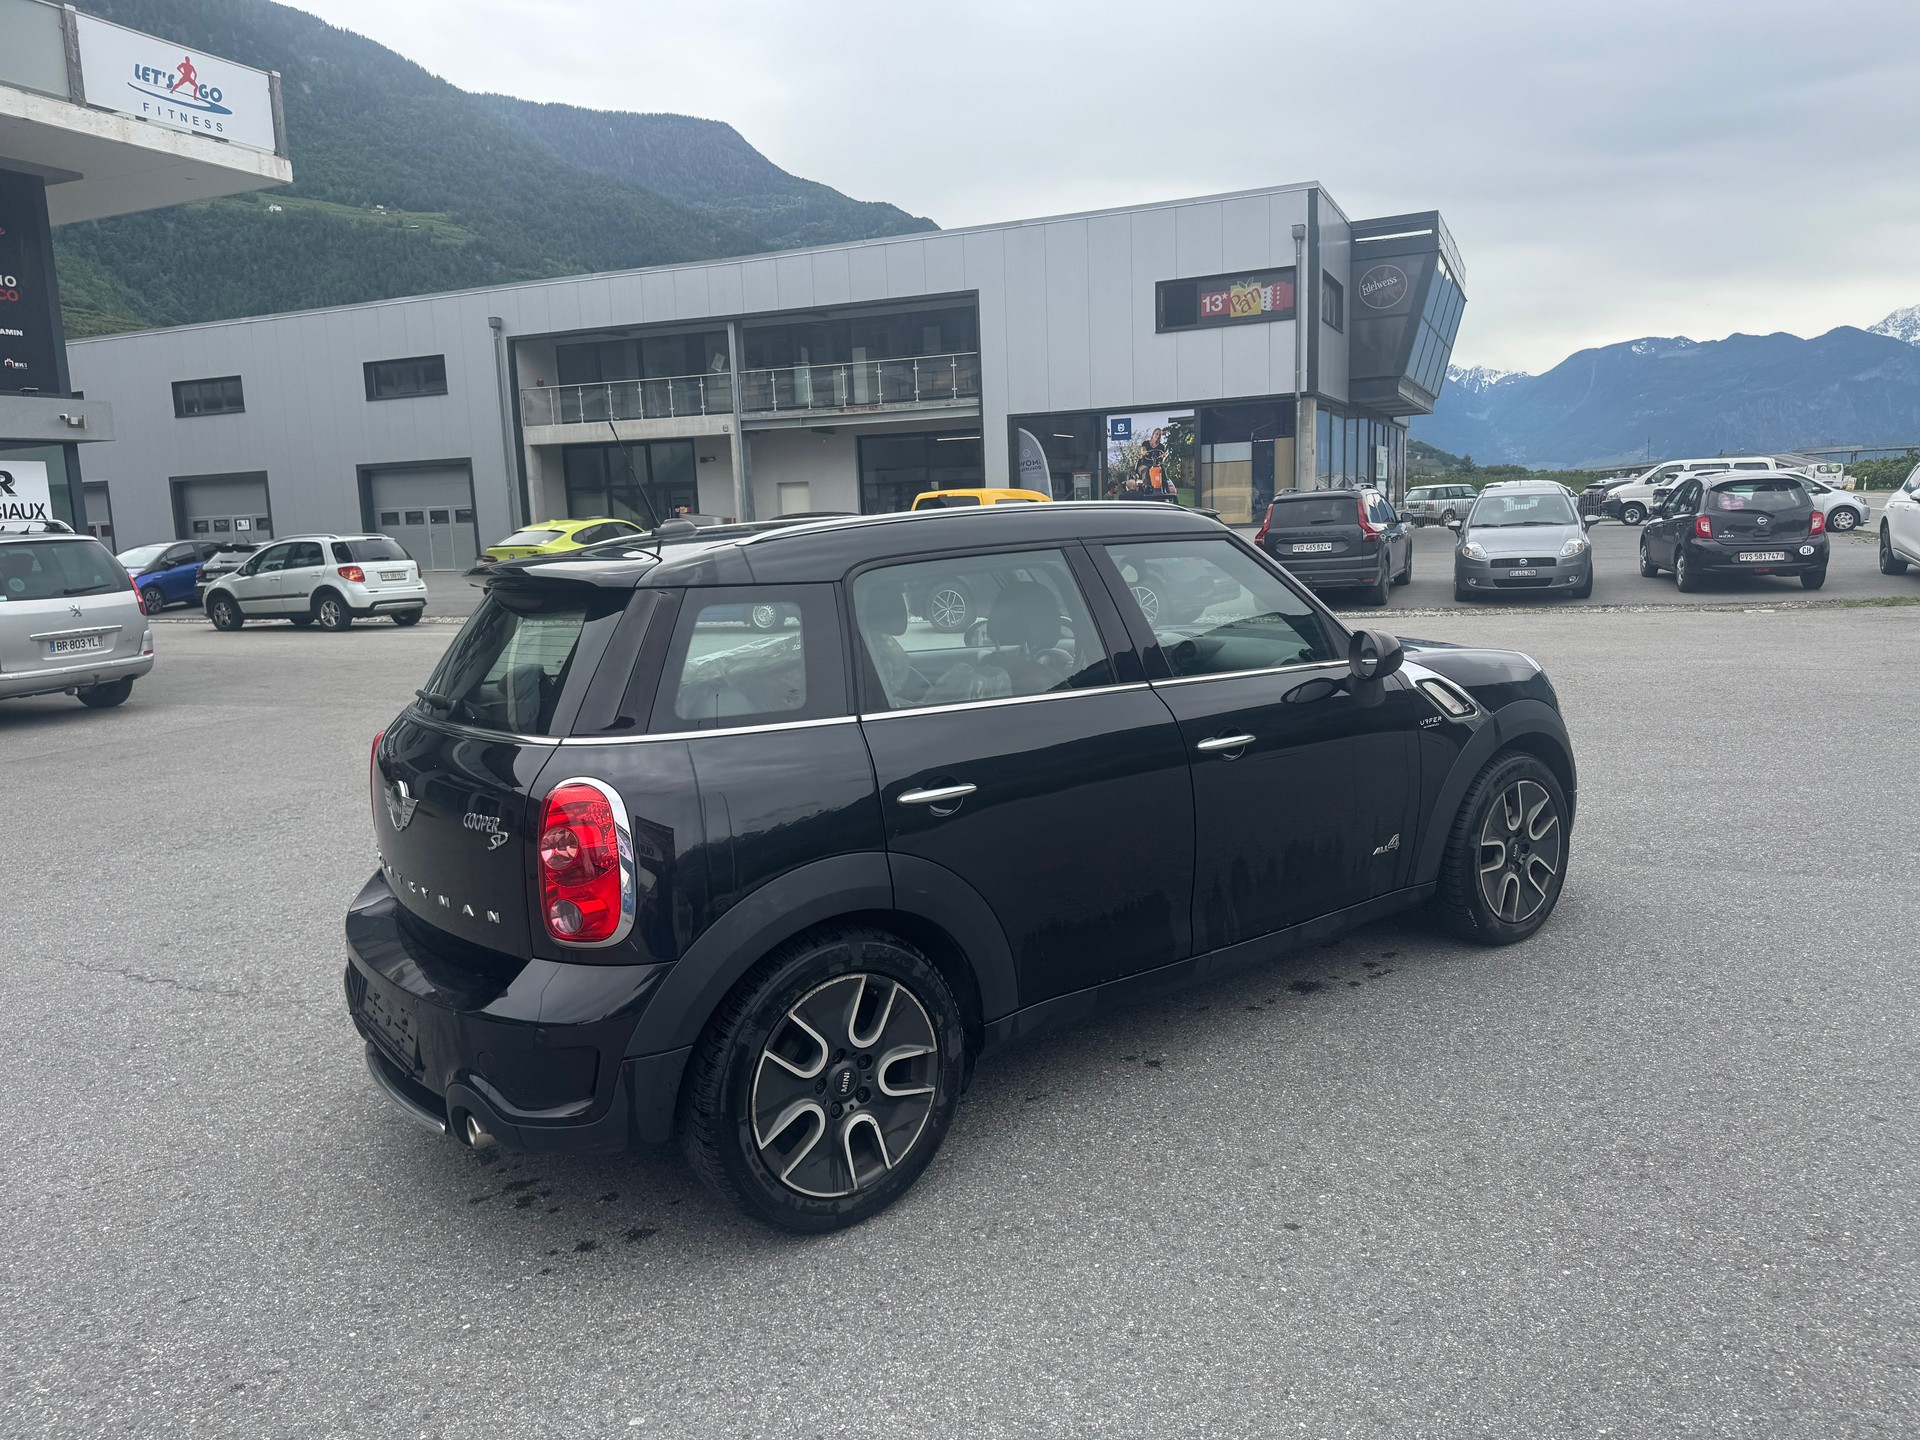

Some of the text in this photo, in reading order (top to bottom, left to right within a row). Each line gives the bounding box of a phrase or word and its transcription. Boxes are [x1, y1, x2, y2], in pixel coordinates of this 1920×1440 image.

[134, 63, 223, 103] LET'S GO
[143, 102, 223, 132] FITNESS
[1361, 276, 1398, 296] Edelweiss
[1231, 287, 1261, 314] Pam
[1802, 547, 1812, 555] CH
[463, 812, 500, 834] COOPER
[840, 1072, 851, 1093] MINI
